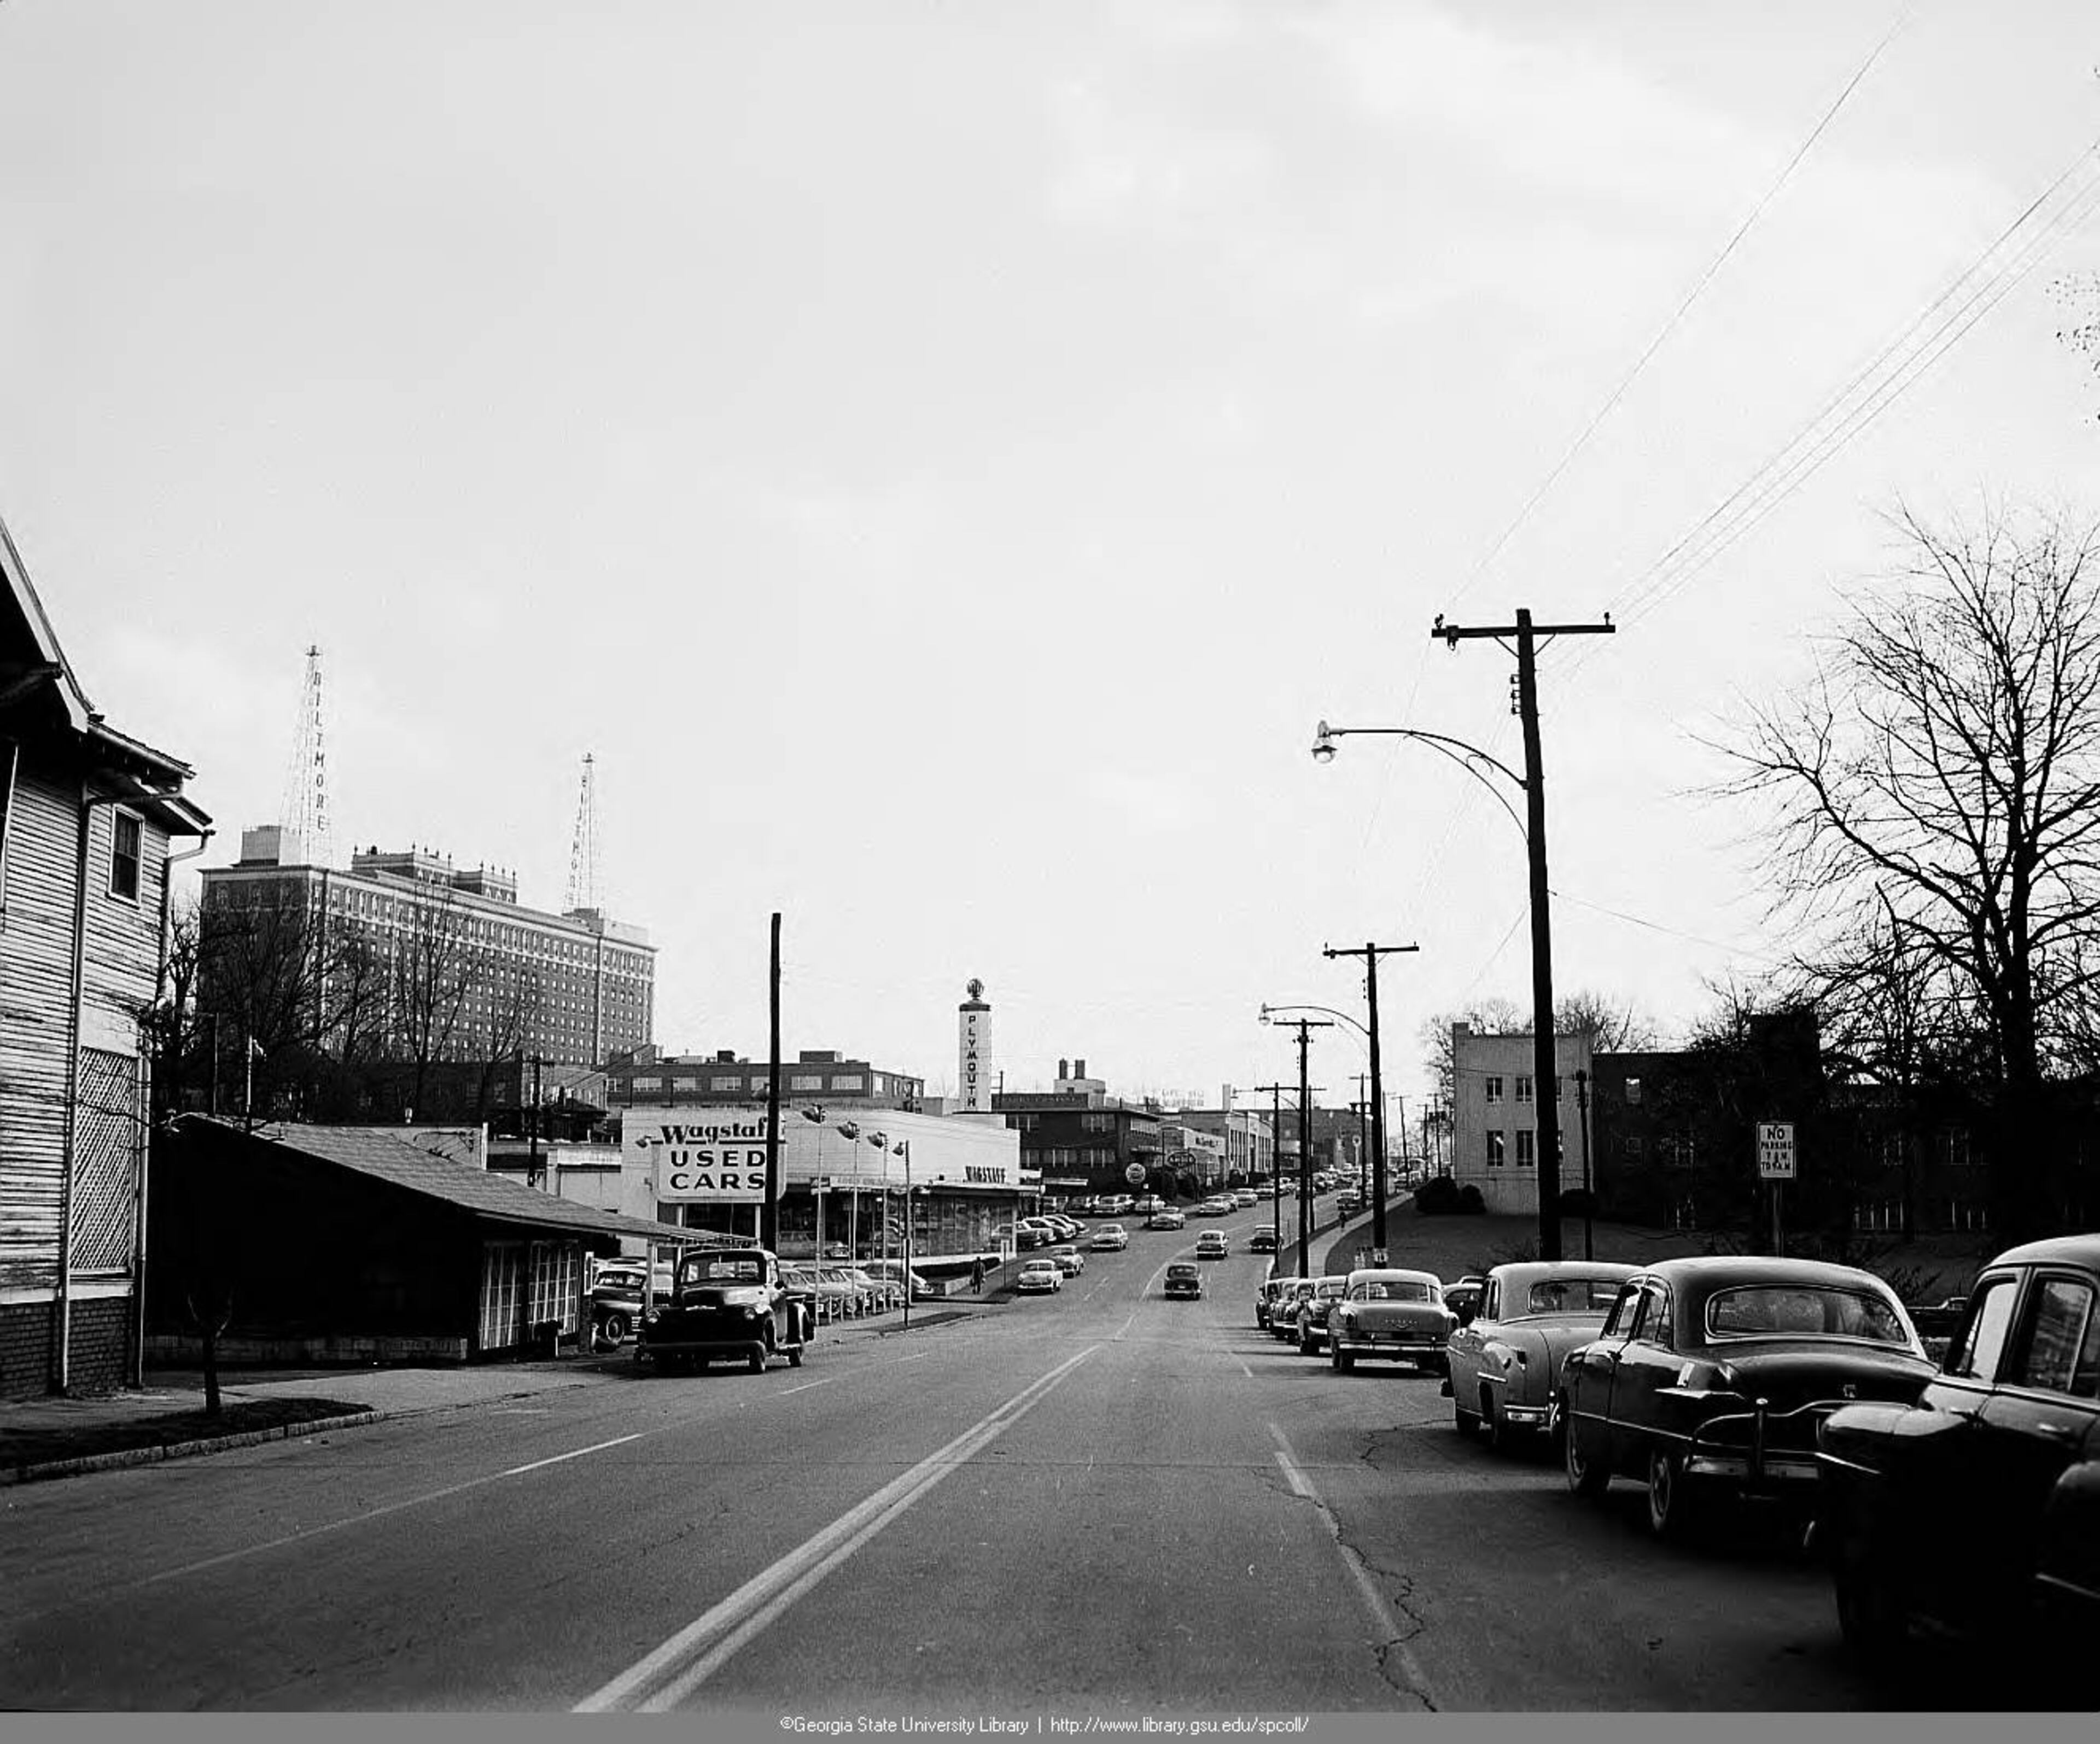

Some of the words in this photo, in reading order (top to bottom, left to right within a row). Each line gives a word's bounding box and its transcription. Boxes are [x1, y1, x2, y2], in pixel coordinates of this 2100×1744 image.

[313, 672, 325, 831] BILTMORE
[967, 1015, 977, 1107] PLYMOUTH
[660, 1116, 768, 1144] Wagstaf
[1767, 1128, 1785, 1140] NO
[1761, 1141, 1792, 1150] PARKING
[671, 1151, 766, 1166] USED
[670, 1174, 766, 1189] CARS
